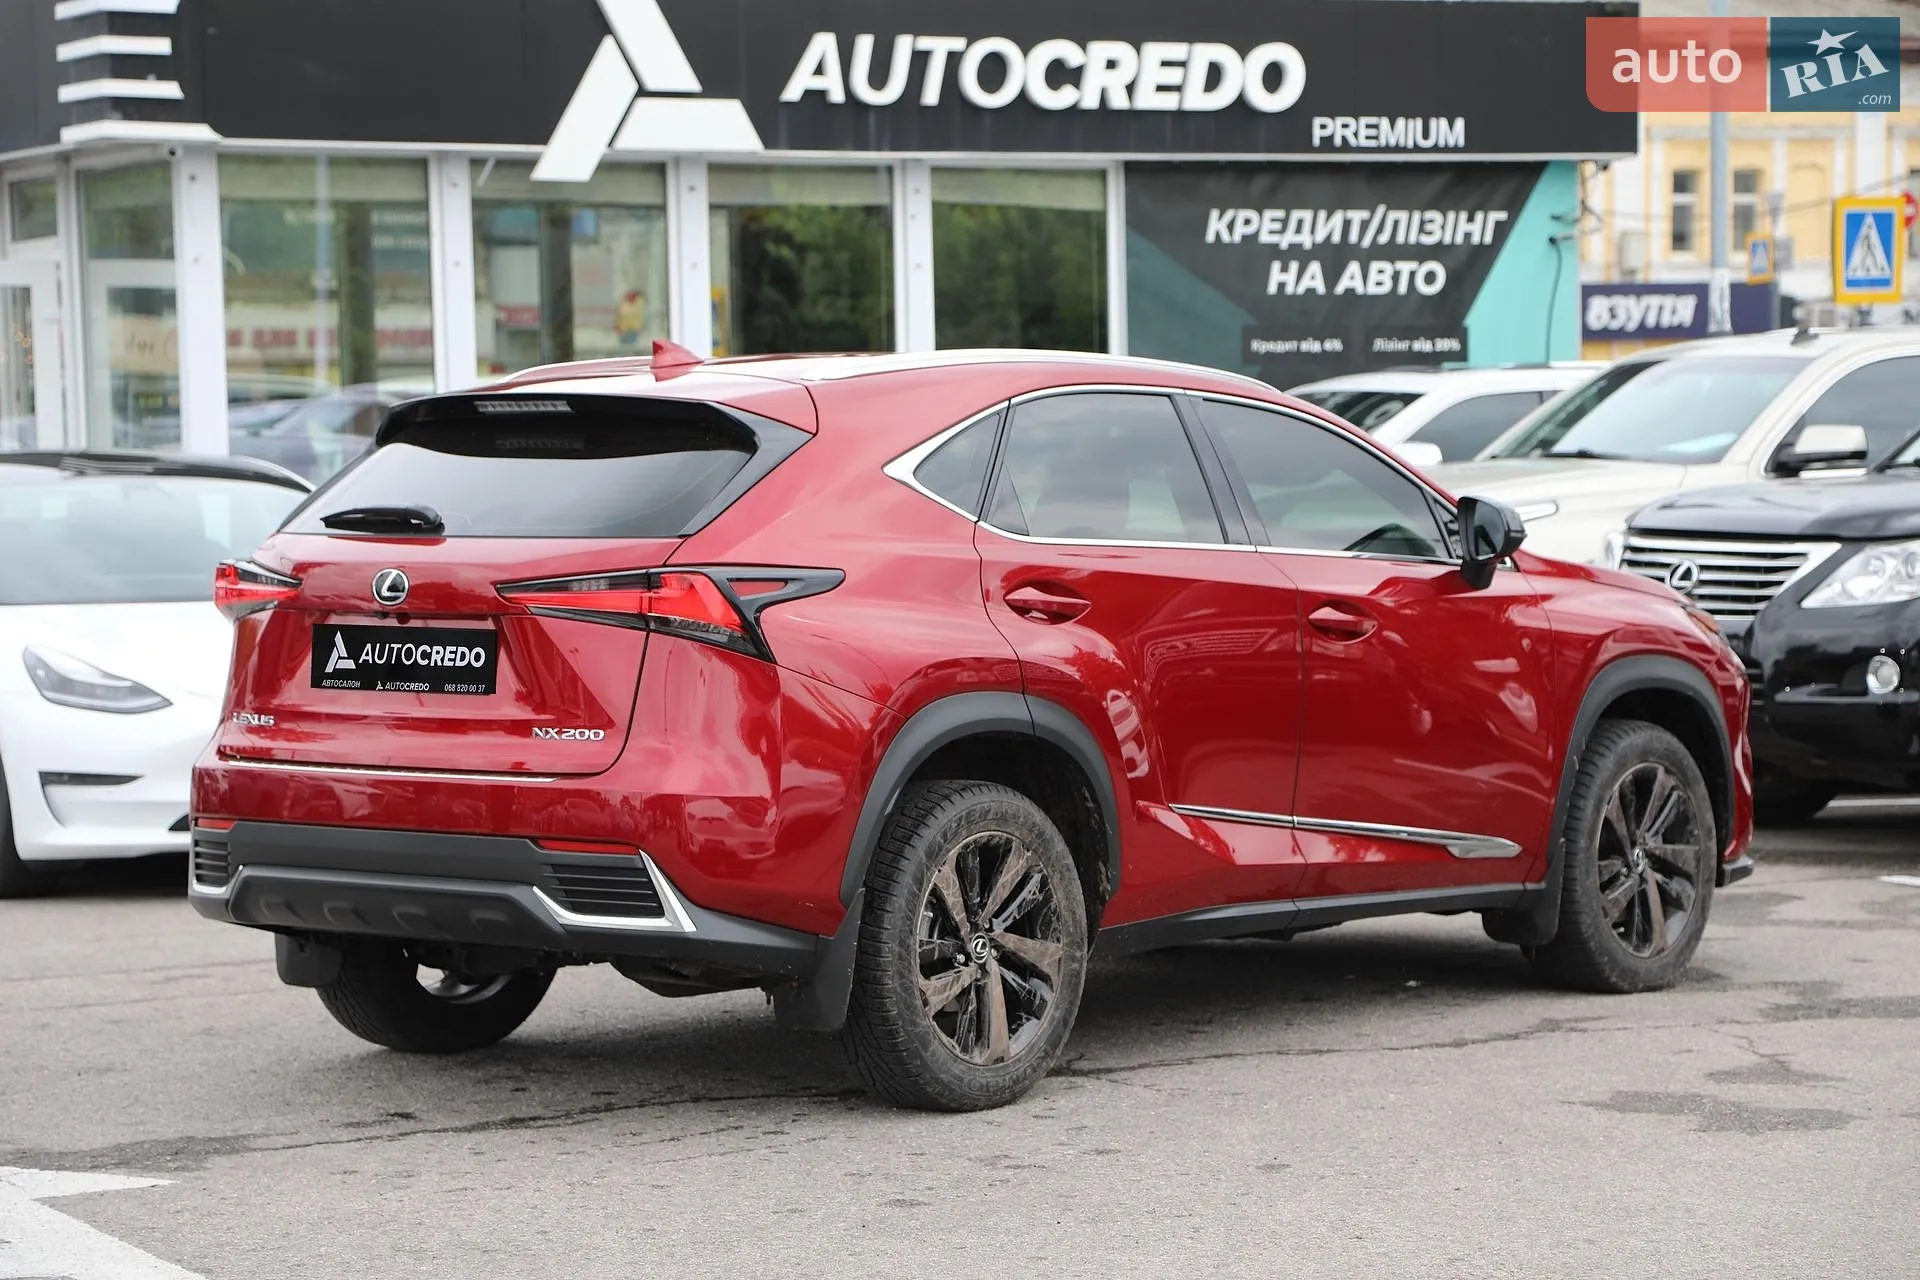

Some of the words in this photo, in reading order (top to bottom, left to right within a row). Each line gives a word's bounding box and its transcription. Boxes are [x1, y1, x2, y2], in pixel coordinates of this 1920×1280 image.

[780, 32, 1306, 113] AUTOCREDO
[1311, 116, 1466, 149] PREMIUM
[1205, 204, 1508, 250] КРЕДИТ/ЛІЗІНГ
[1266, 260, 1327, 296] НА
[1333, 260, 1447, 296] АВТО
[358, 642, 487, 668] AUTOCREDO
[321, 679, 361, 689] АВТОСАЛОН
[385, 682, 430, 692] AUTOCREDO
[478, 684, 486, 693] 37
[232, 712, 275, 727] LEXUS
